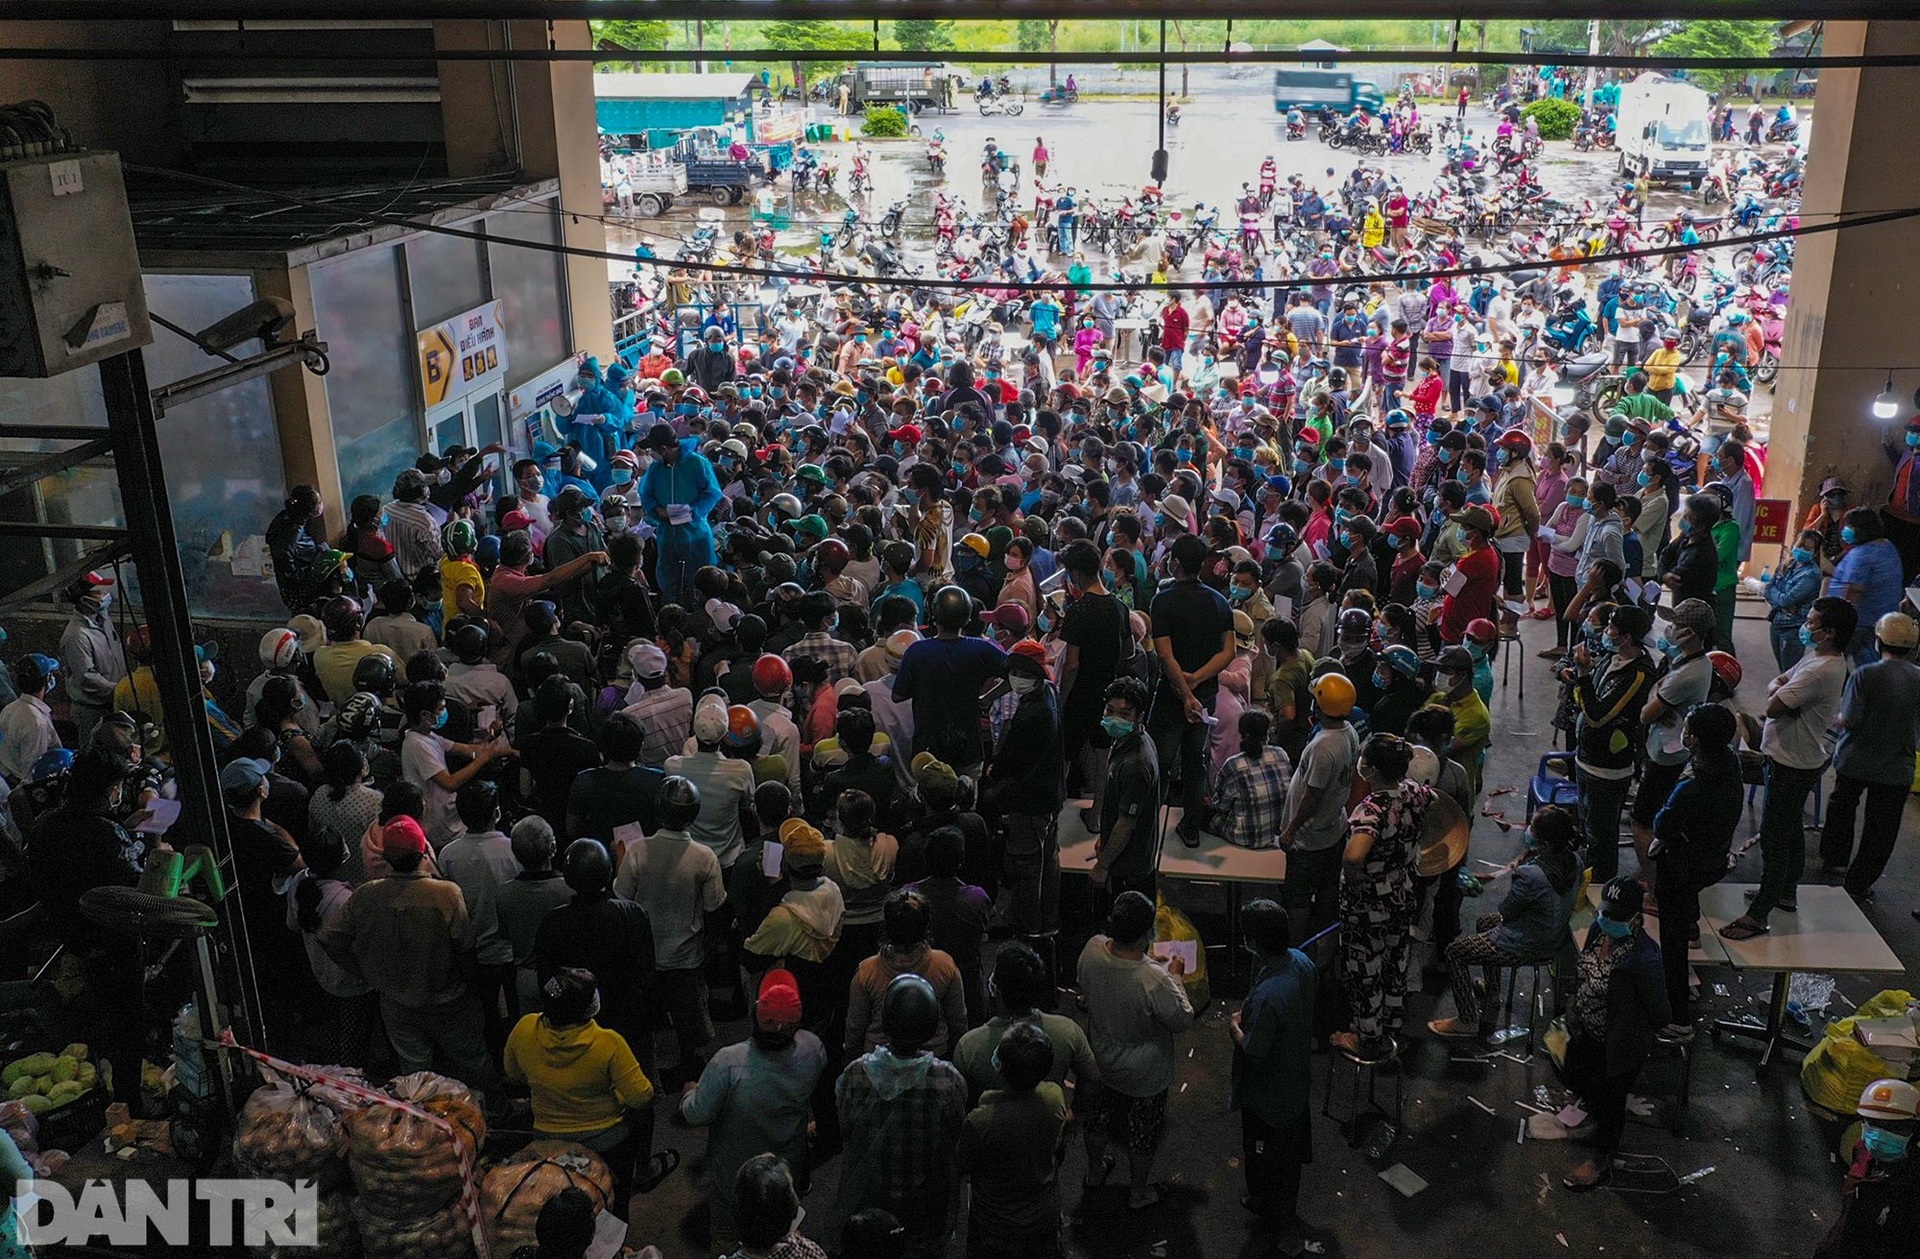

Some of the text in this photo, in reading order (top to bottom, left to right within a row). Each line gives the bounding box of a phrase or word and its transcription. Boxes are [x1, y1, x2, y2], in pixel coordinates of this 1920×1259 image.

[468, 315, 483, 331] BAN
[1761, 525, 1777, 537] XE
[1607, 885, 1621, 900] NY
